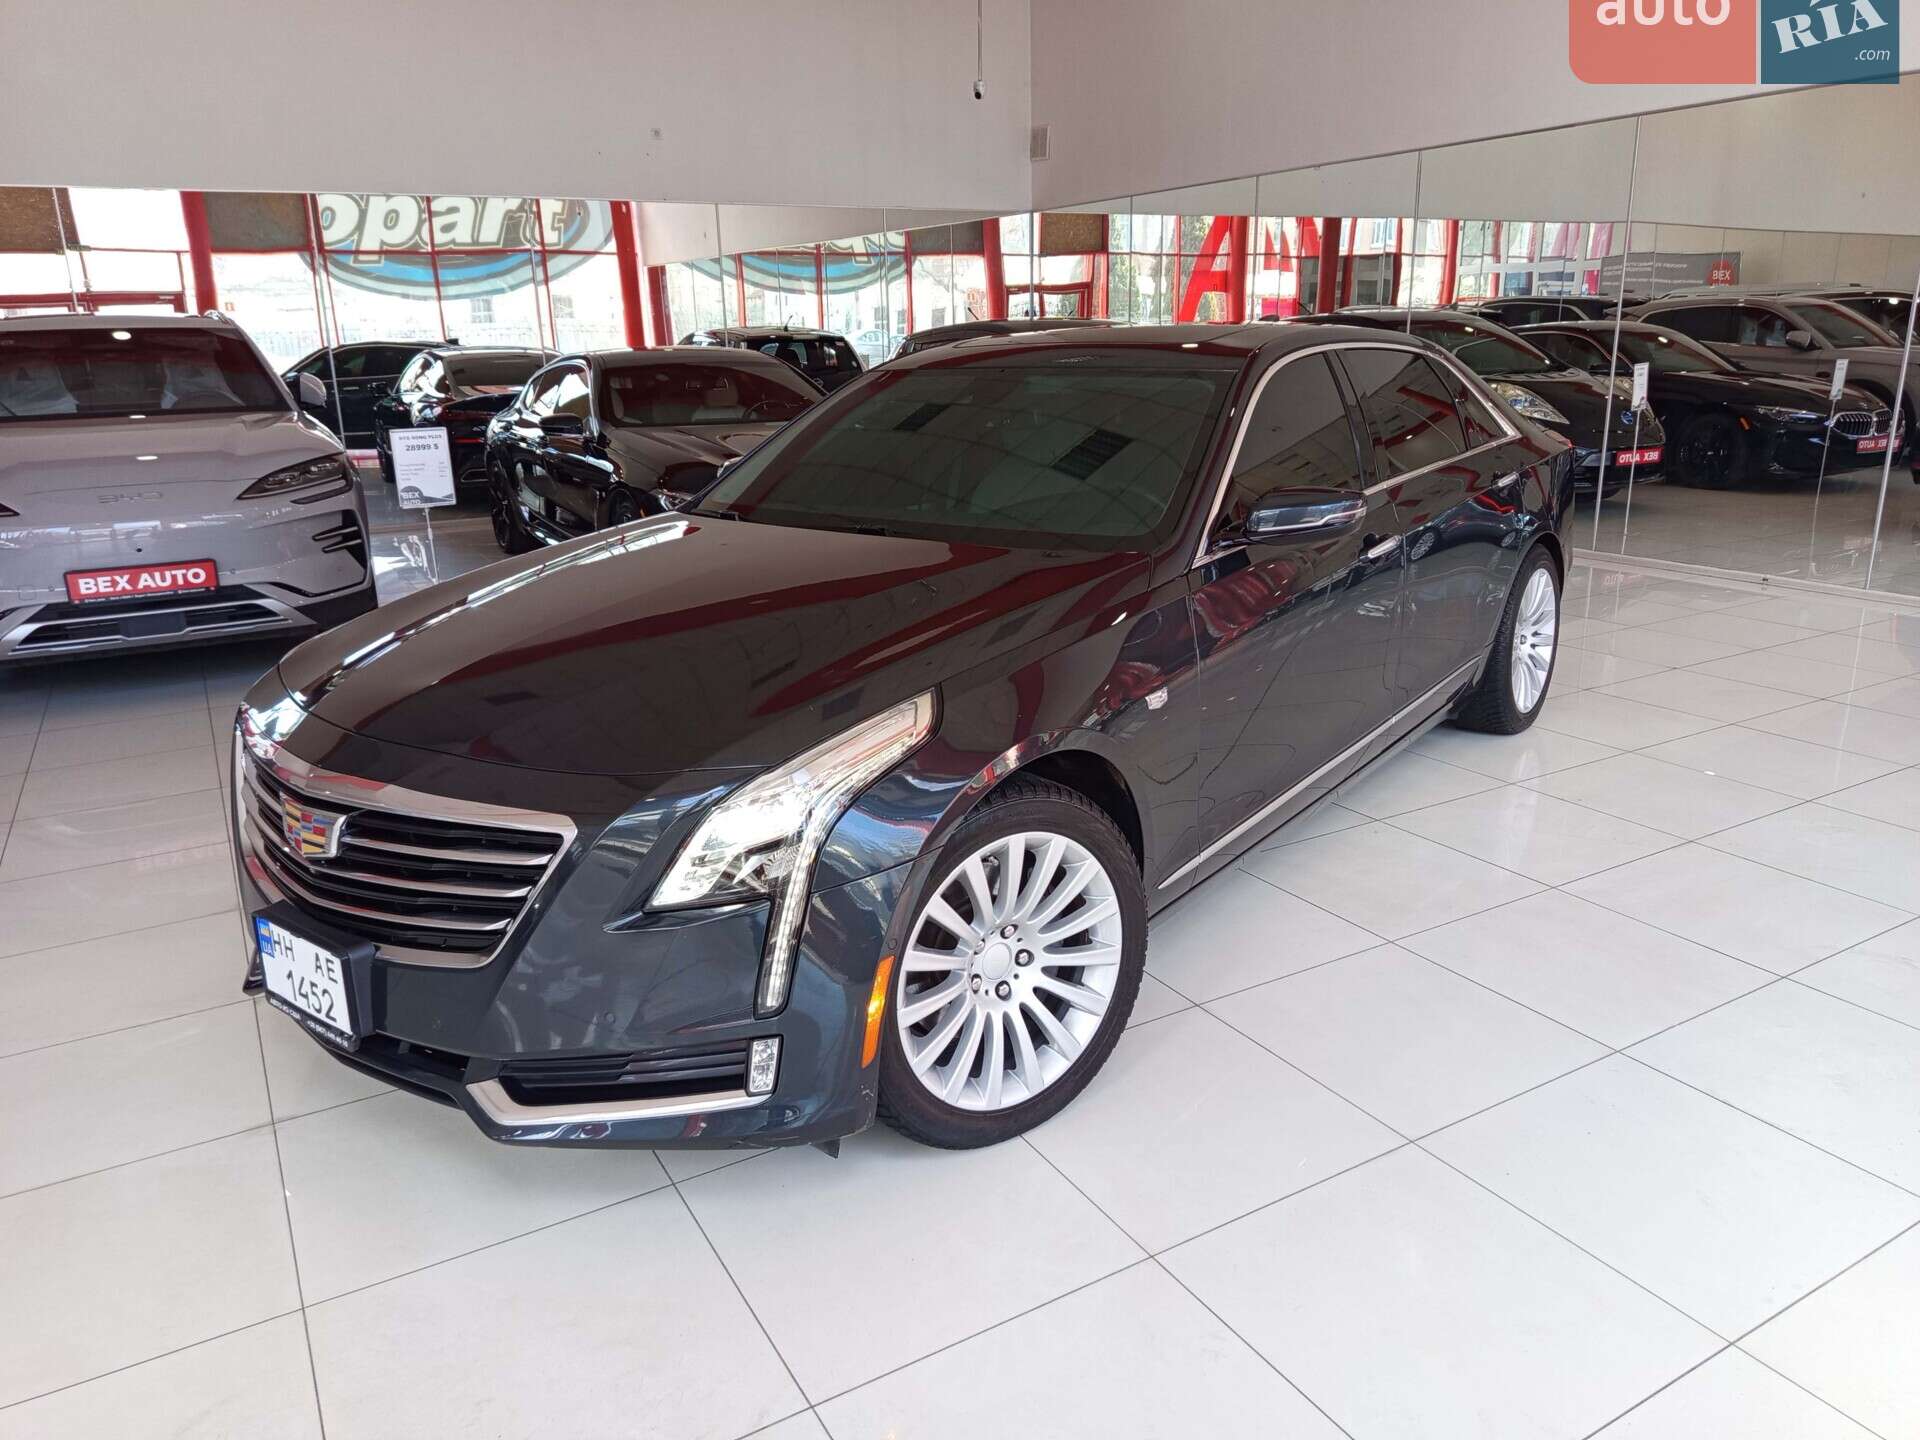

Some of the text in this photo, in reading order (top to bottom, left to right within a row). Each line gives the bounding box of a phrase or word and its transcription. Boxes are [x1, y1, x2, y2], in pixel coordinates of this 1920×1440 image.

[402, 490, 420, 499] BEX
[78, 574, 133, 596] BEX
[137, 567, 207, 590] AUTO
[271, 930, 339, 985] HH AE
[286, 969, 338, 1023] 1452
